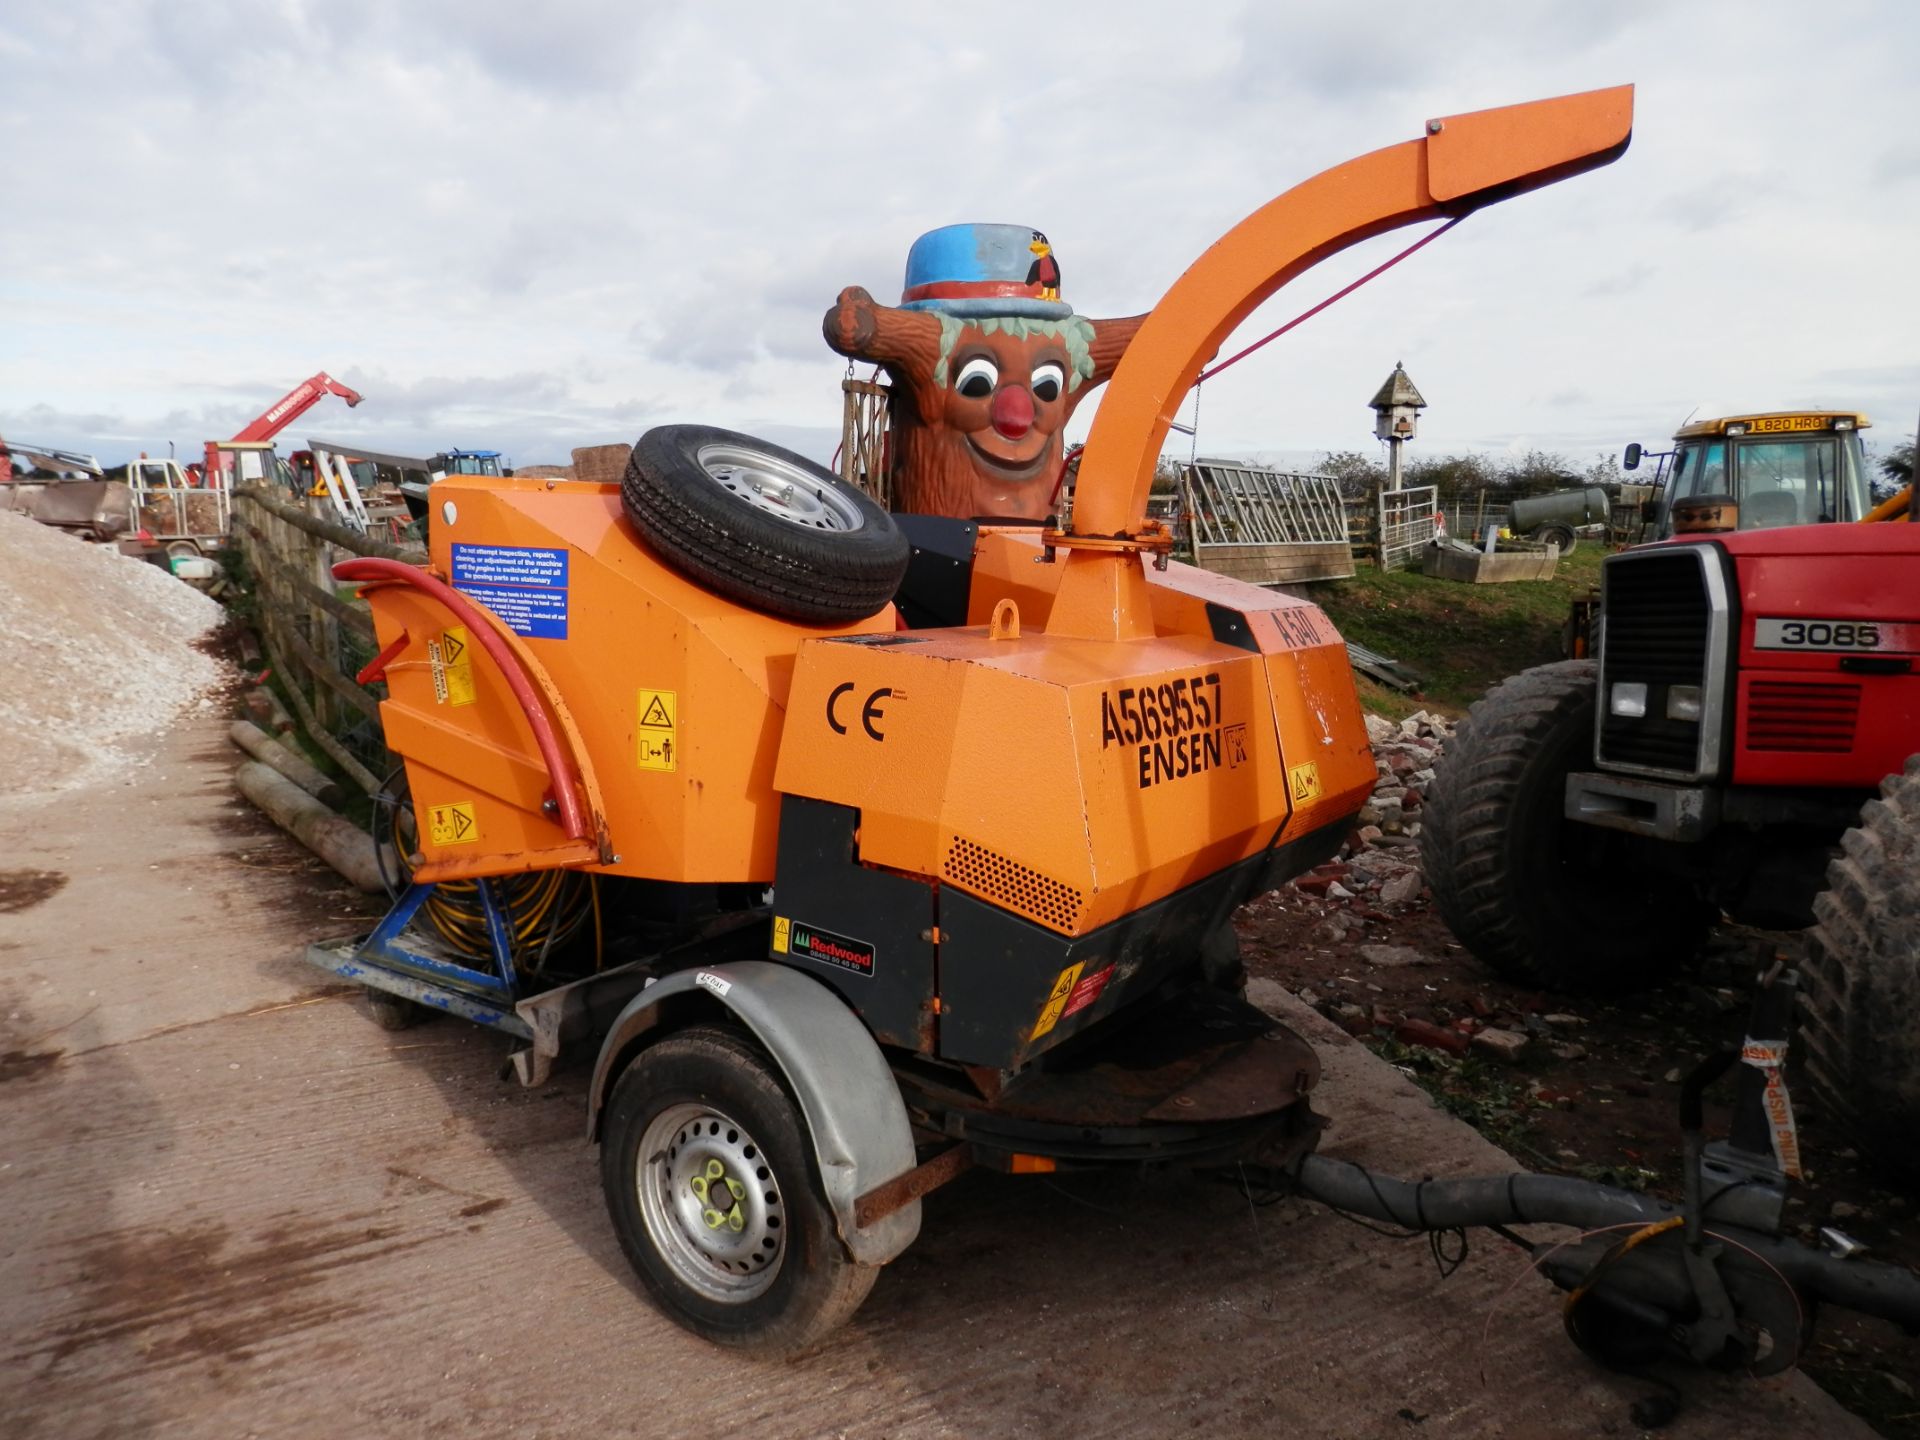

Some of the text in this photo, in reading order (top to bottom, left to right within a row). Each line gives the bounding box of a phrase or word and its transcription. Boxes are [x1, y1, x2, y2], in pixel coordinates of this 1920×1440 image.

[1755, 419, 1791, 431] L820
[476, 548, 498, 556] attempt
[499, 549, 531, 558] inspection,
[532, 552, 556, 560] repairs,
[484, 556, 516, 566] adjustment
[502, 566, 529, 574] switched
[520, 576, 551, 585] stationary
[1781, 623, 1880, 647] 3085
[1101, 673, 1222, 750] A569557
[1139, 728, 1222, 789] ENSEN
[809, 936, 871, 967] Redwood
